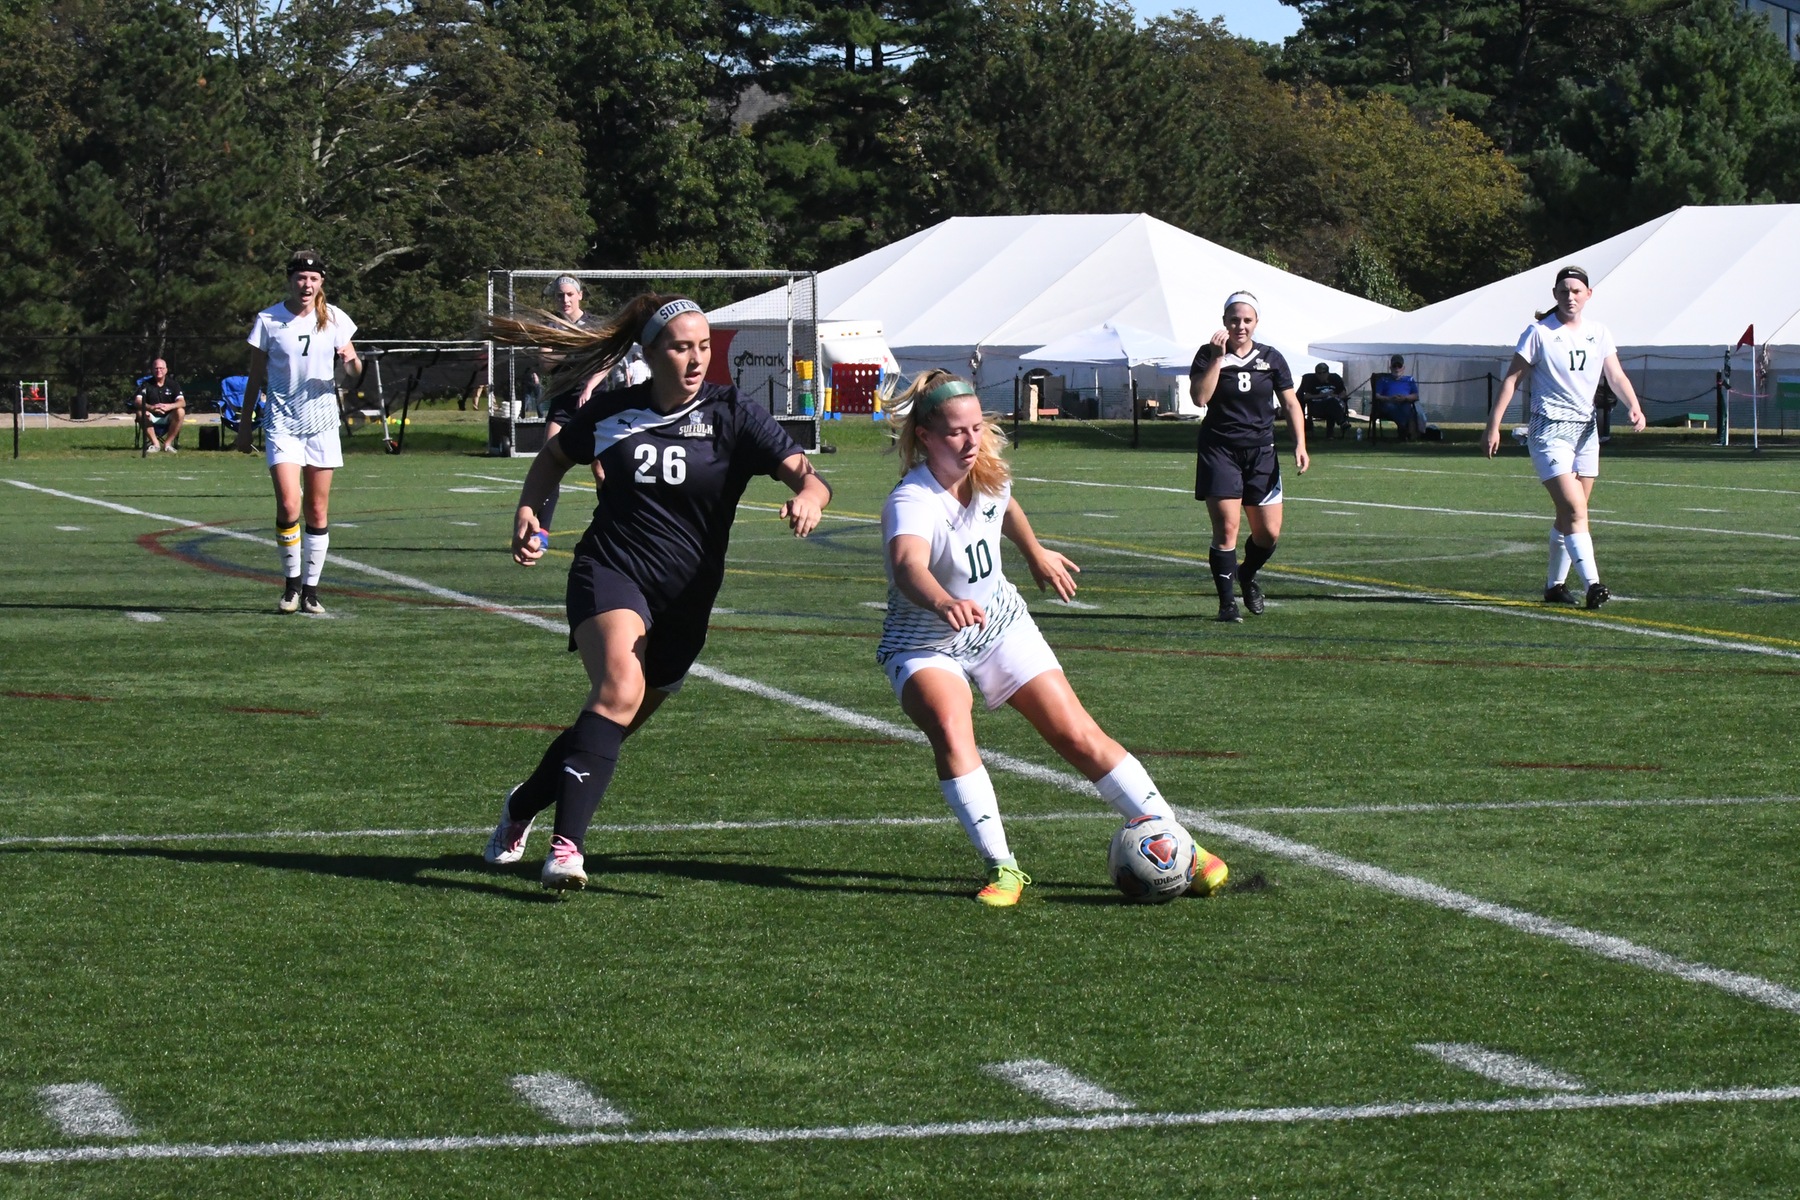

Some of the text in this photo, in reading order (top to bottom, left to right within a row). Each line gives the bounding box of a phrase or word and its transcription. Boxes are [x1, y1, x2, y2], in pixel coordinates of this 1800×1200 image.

[298, 334, 310, 357] 7
[1569, 350, 1586, 371] 17
[1237, 371, 1252, 392] 8
[679, 424, 714, 435] SUFFOLK
[634, 443, 687, 486] 26
[964, 538, 993, 584] 10
